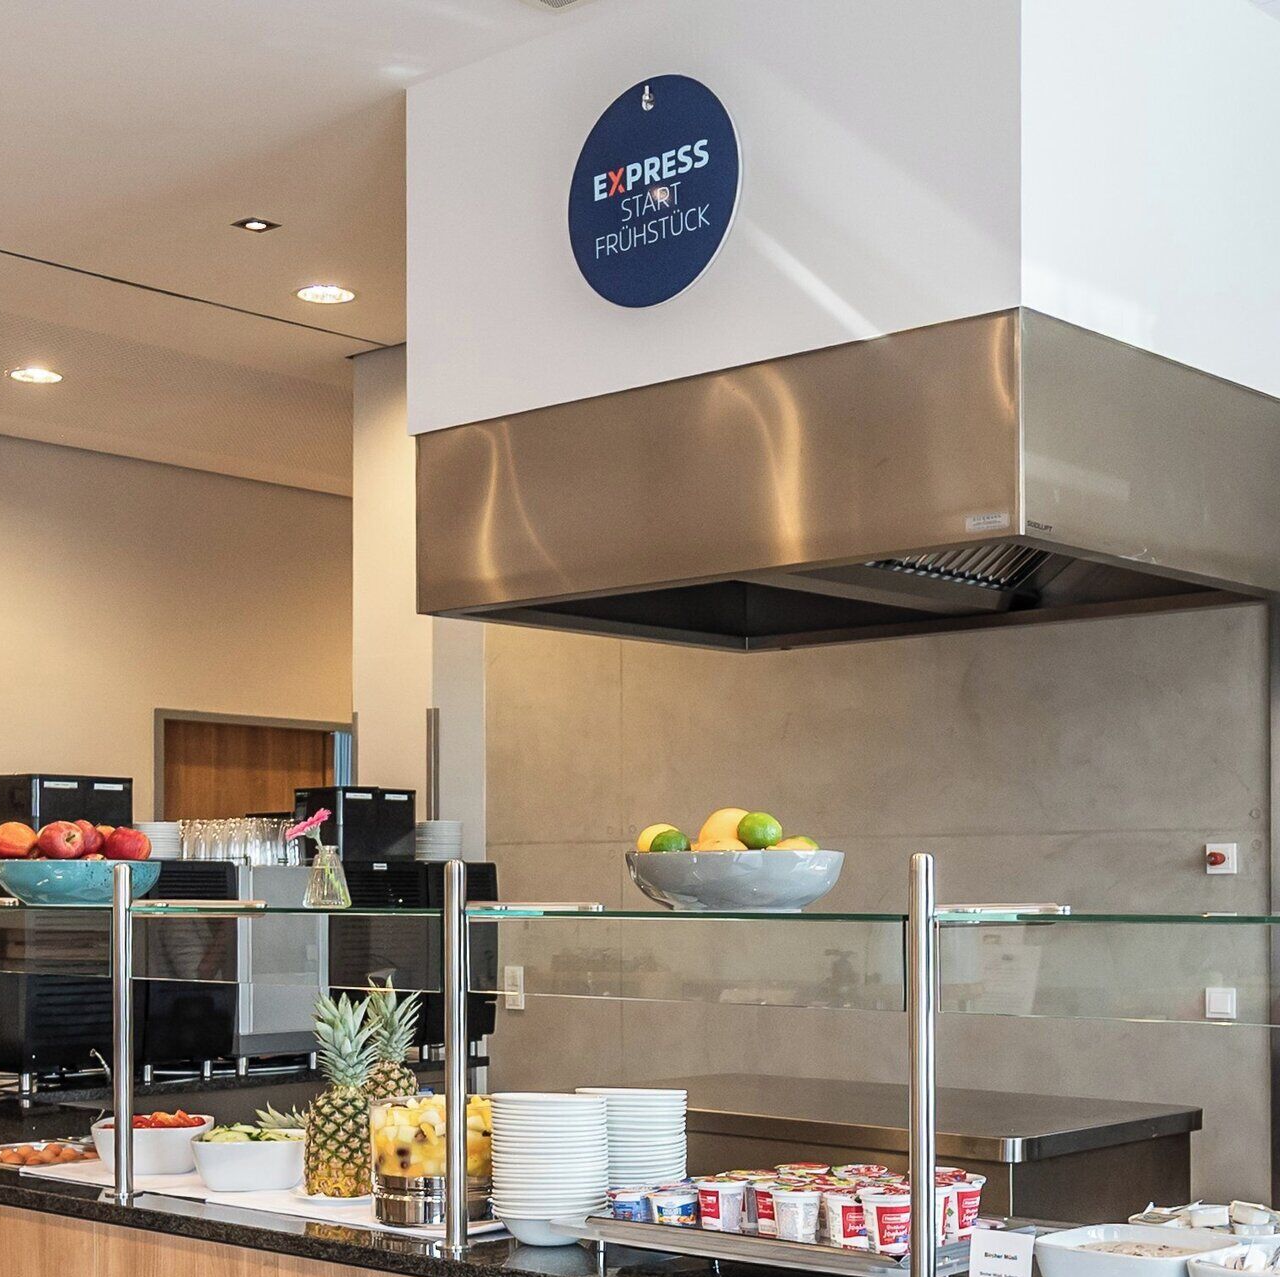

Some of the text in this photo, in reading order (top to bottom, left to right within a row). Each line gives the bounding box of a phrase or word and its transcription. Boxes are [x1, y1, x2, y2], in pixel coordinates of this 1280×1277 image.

[593, 139, 710, 201] EXPRESS
[621, 181, 682, 222] START
[595, 203, 711, 260] FRÜHSTÜCK
